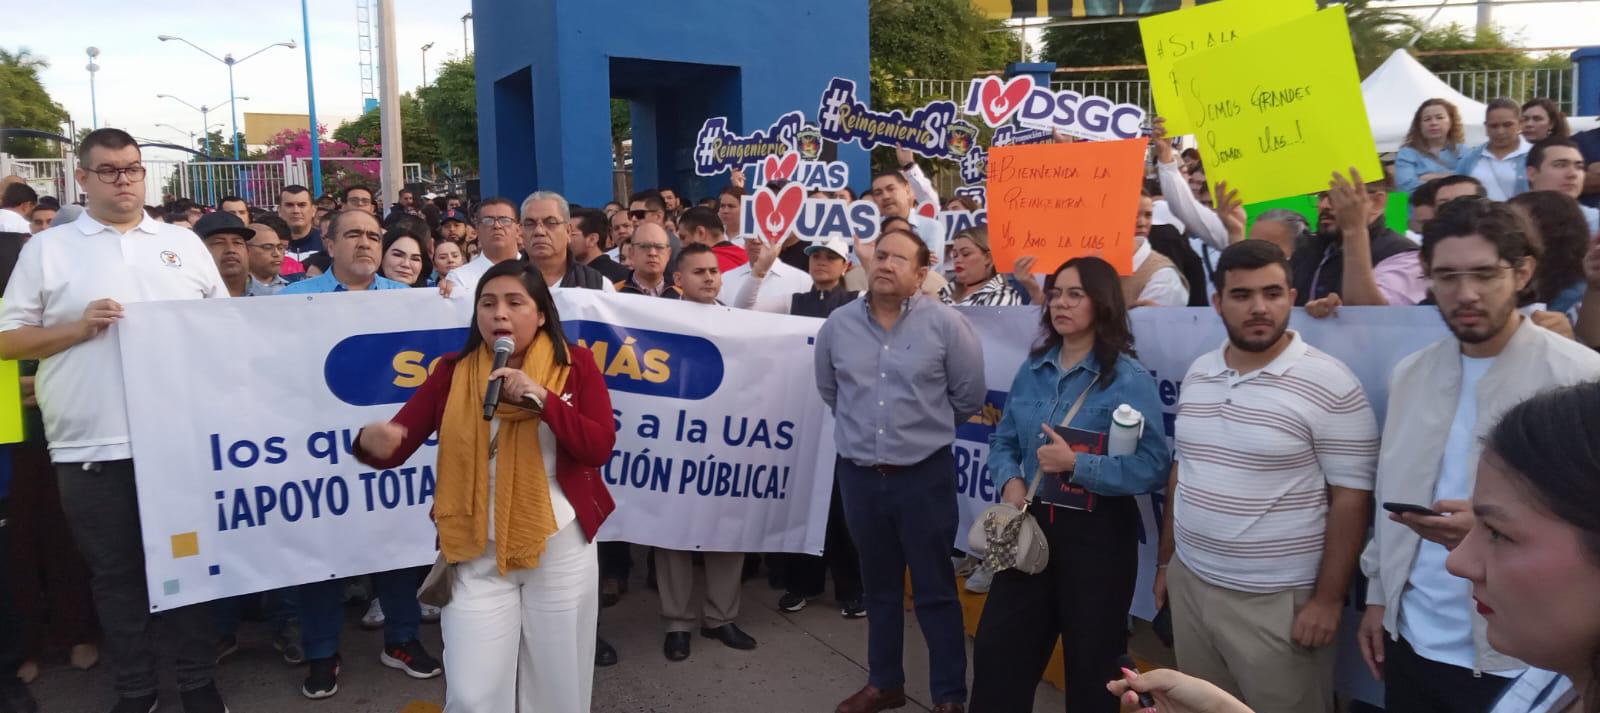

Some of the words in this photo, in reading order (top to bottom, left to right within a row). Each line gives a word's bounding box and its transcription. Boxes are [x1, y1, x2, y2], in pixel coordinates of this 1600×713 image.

[1022, 90, 1141, 139] DSGC
[796, 203, 876, 240] UAS
[209, 433, 288, 471] los
[307, 429, 354, 464] qu
[637, 413, 660, 439] a
[676, 409, 707, 443] la
[723, 416, 795, 450] UAS
[215, 475, 349, 531] ¡APOYO
[359, 465, 436, 512] TOTA
[679, 454, 790, 499] PÚBLICA!
